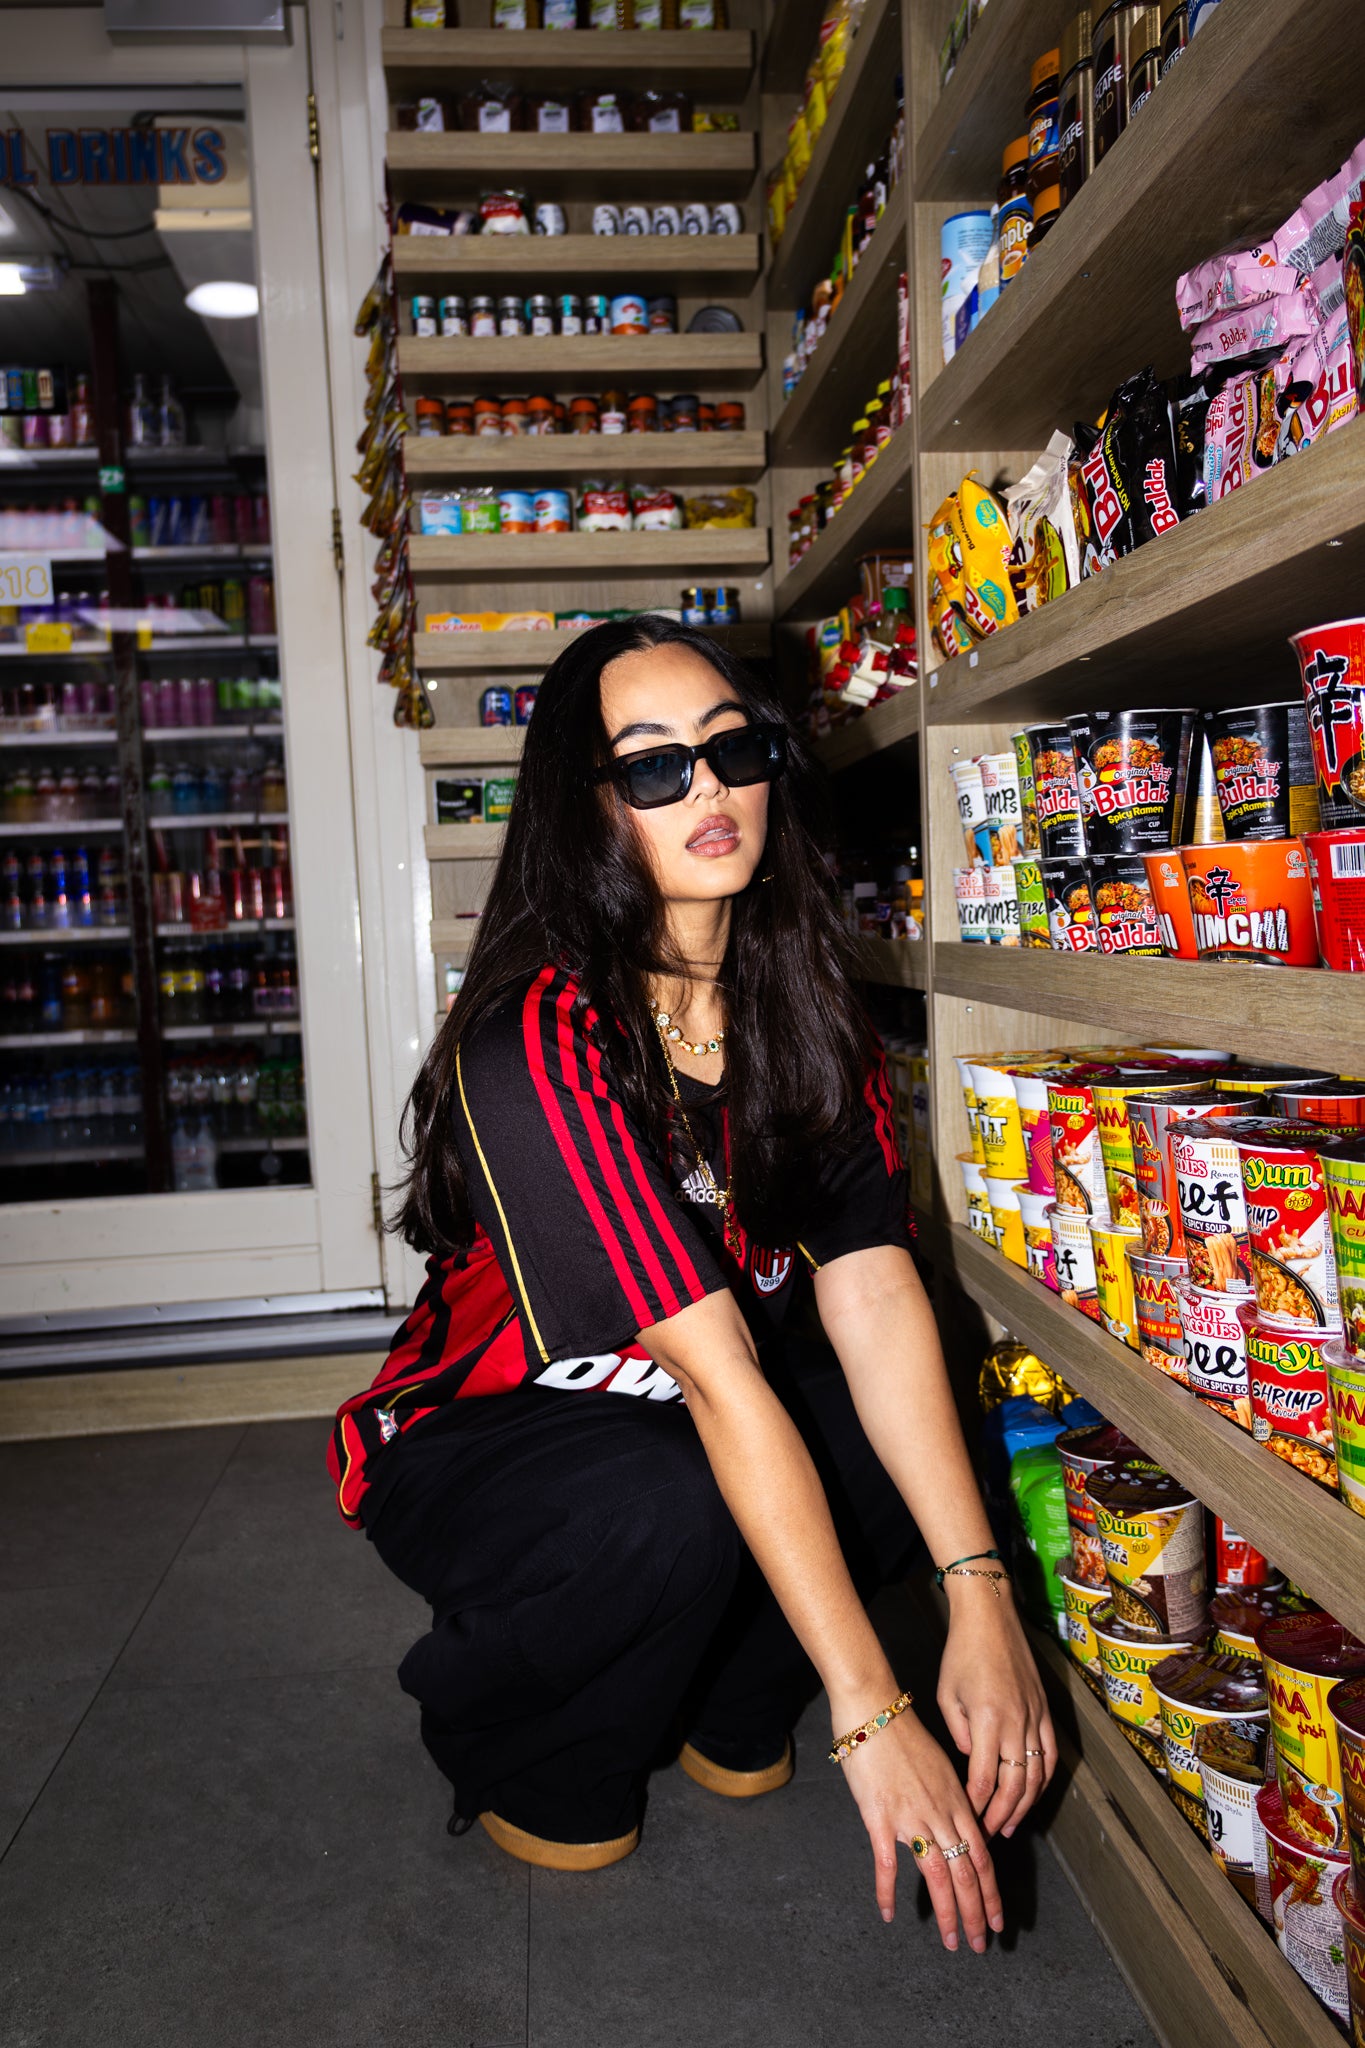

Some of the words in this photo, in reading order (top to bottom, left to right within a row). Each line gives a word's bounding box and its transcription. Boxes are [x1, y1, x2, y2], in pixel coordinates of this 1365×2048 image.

[46, 127, 227, 185] DRINKS
[1219, 328, 1247, 352] Buldak
[1119, 488, 1131, 512] HOT
[1143, 458, 1180, 536] Buldak
[0, 564, 49, 598] 18
[1114, 768, 1148, 781] Original
[1224, 764, 1252, 777] Original
[1043, 777, 1069, 789] Original
[1092, 780, 1169, 816] Buldak
[1216, 777, 1280, 813] Buldak
[1107, 810, 1132, 824] Spicy
[1133, 805, 1164, 818] Ramen
[1226, 806, 1244, 821] Spicy
[1242, 801, 1275, 813] Ramen
[1042, 814, 1057, 830] Spicy
[1205, 866, 1240, 917] 辛
[1110, 911, 1142, 923] Original
[1210, 1169, 1239, 1180] Ramen
[674, 1187, 726, 1203] adidas
[1188, 1219, 1204, 1231] SPICY
[1205, 1223, 1228, 1233] SOUP
[760, 1277, 781, 1288] 1899
[1190, 1305, 1226, 1323] CUP
[1160, 1324, 1178, 1335] YUM
[1182, 1313, 1241, 1340] NOODLES
[1210, 1382, 1233, 1394] SPICY
[1252, 1381, 1323, 1411] SHRIMP
[1267, 1405, 1299, 1418] FLAVOUR
[1329, 1987, 1348, 1998] Netto
